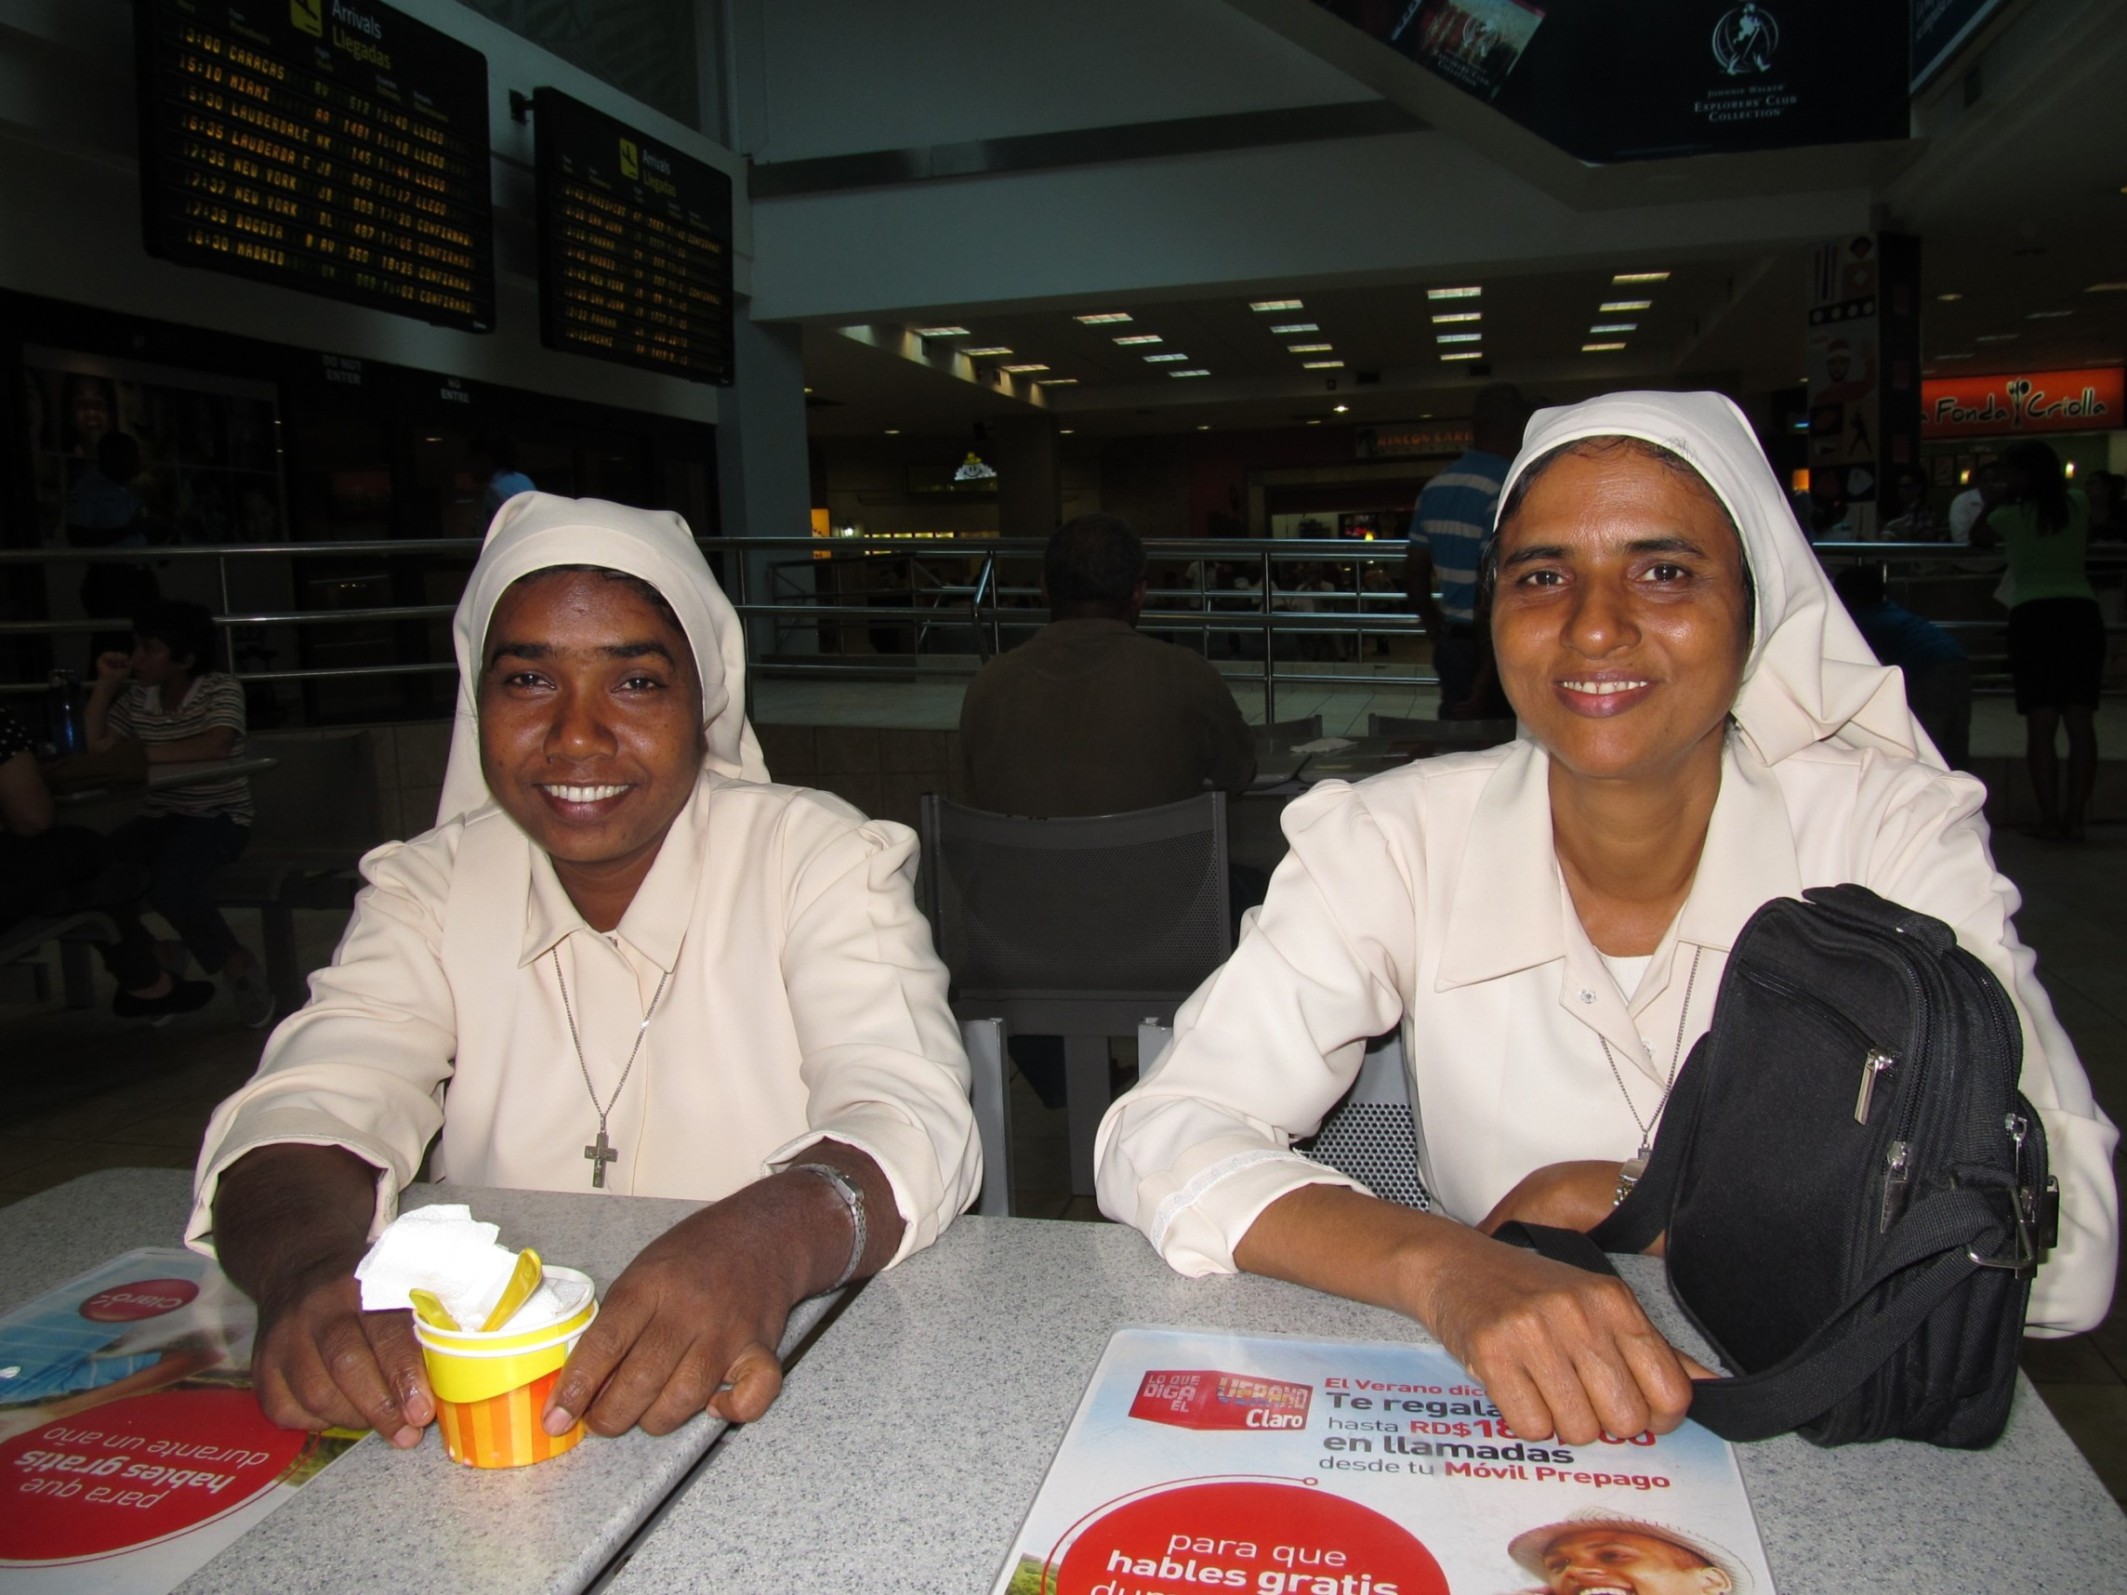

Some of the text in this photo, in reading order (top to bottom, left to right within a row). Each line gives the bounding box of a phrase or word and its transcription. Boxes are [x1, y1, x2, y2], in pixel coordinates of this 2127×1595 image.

[331, 0, 383, 40] Arrivals
[332, 25, 392, 70] Llegadas
[229, 45, 287, 81] CARACAS
[413, 123, 445, 146] LLEGO
[1765, 95, 1798, 106] CLUB
[229, 75, 271, 103] MIAMI
[414, 147, 446, 170] LLEGO
[1709, 108, 1781, 122] COLLECTION
[231, 101, 310, 143] LAUDERDALE
[415, 172, 446, 194] LLEGO
[233, 158, 259, 179] NEW
[267, 168, 299, 192] YORK
[234, 186, 260, 206] NEW
[267, 195, 300, 219] YORK
[415, 196, 447, 217] LLEGO
[235, 213, 285, 241] BOGOTA
[236, 241, 287, 267] MADRID
[325, 367, 362, 386] ENTER
[1936, 395, 2009, 424] Fonda
[2026, 387, 2108, 418] Criolla
[107, 1293, 183, 1310] Claro
[1143, 1384, 1197, 1402] DIGA
[1149, 1374, 1201, 1388] LO QUE
[1325, 1377, 1490, 1397] El Verano dic
[1326, 1392, 1374, 1411] Te
[1246, 1408, 1304, 1429] Claro
[1328, 1417, 1399, 1432] hasta
[43, 1426, 269, 1469] durante un año
[1323, 1435, 1575, 1464] en llamadas
[14, 1450, 237, 1494] hables gratis
[1319, 1455, 1671, 1491] desde tu Móvil Prepago
[19, 1478, 170, 1509] para que
[1167, 1534, 1348, 1568] para que
[1107, 1550, 1400, 1595] hables gratis
